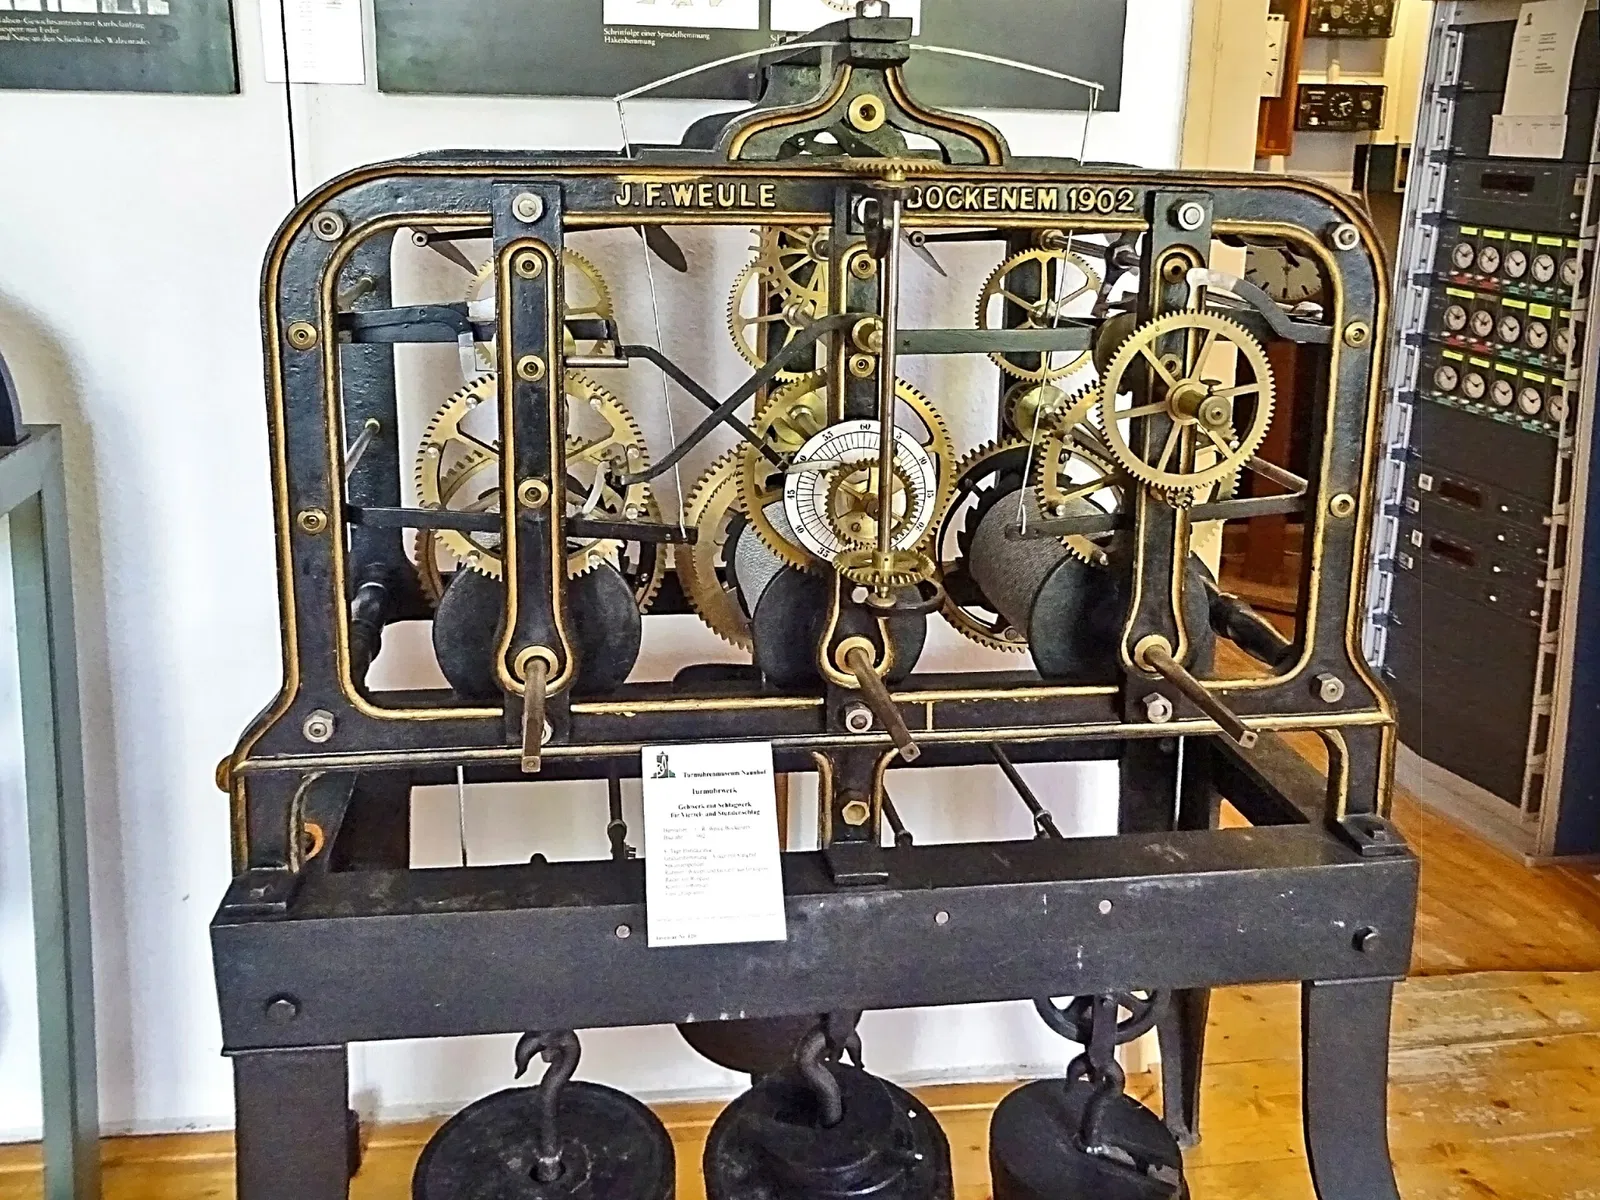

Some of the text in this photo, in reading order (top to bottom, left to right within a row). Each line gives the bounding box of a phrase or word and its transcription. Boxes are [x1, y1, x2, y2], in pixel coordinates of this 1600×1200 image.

[603, 28, 640, 37] Schrittfolge
[657, 30, 710, 40] Spindelhemmung
[604, 36, 656, 46] Hakenhemmung
[1069, 188, 1135, 213] 1902
[859, 423, 871, 431] 60
[822, 430, 834, 442] 55
[918, 456, 928, 465] 10
[786, 489, 796, 500] 45
[926, 489, 935, 499] 15
[916, 521, 925, 532] 20
[816, 547, 830, 558] 35
